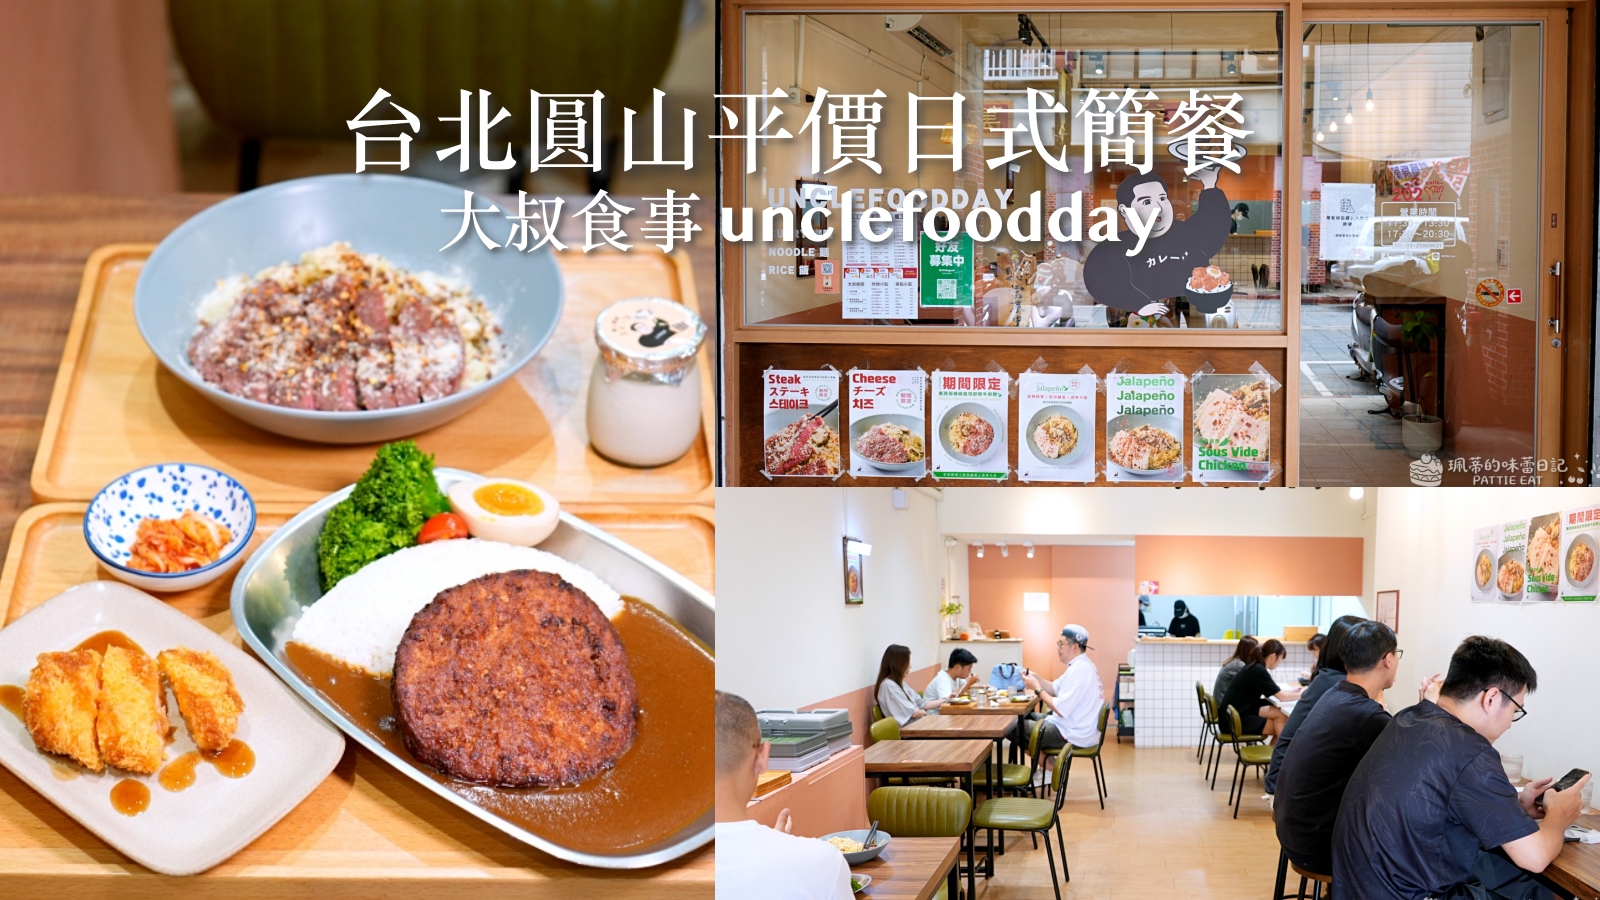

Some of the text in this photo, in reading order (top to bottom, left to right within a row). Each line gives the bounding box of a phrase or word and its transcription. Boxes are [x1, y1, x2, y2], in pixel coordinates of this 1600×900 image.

[1400, 207, 1437, 217] 營業時間
[768, 247, 815, 257] NOODLE
[934, 241, 960, 253] 好友
[929, 254, 965, 268] 募集中
[1146, 254, 1180, 268] カレー
[768, 265, 795, 275] RICE
[769, 374, 801, 385] Steak
[852, 373, 897, 384] Cheese
[943, 376, 1001, 391] 期間限定
[1116, 376, 1175, 388] Jalapeño
[769, 387, 810, 397] ステーキ
[853, 386, 886, 397] チーズ
[1116, 390, 1175, 403] Jalapeño
[769, 399, 809, 410] 스테이크
[852, 398, 875, 410] 치즈
[1116, 404, 1175, 417] Jalapeño
[1198, 446, 1259, 457] Sous Vide
[1198, 459, 1247, 471] Chicken
